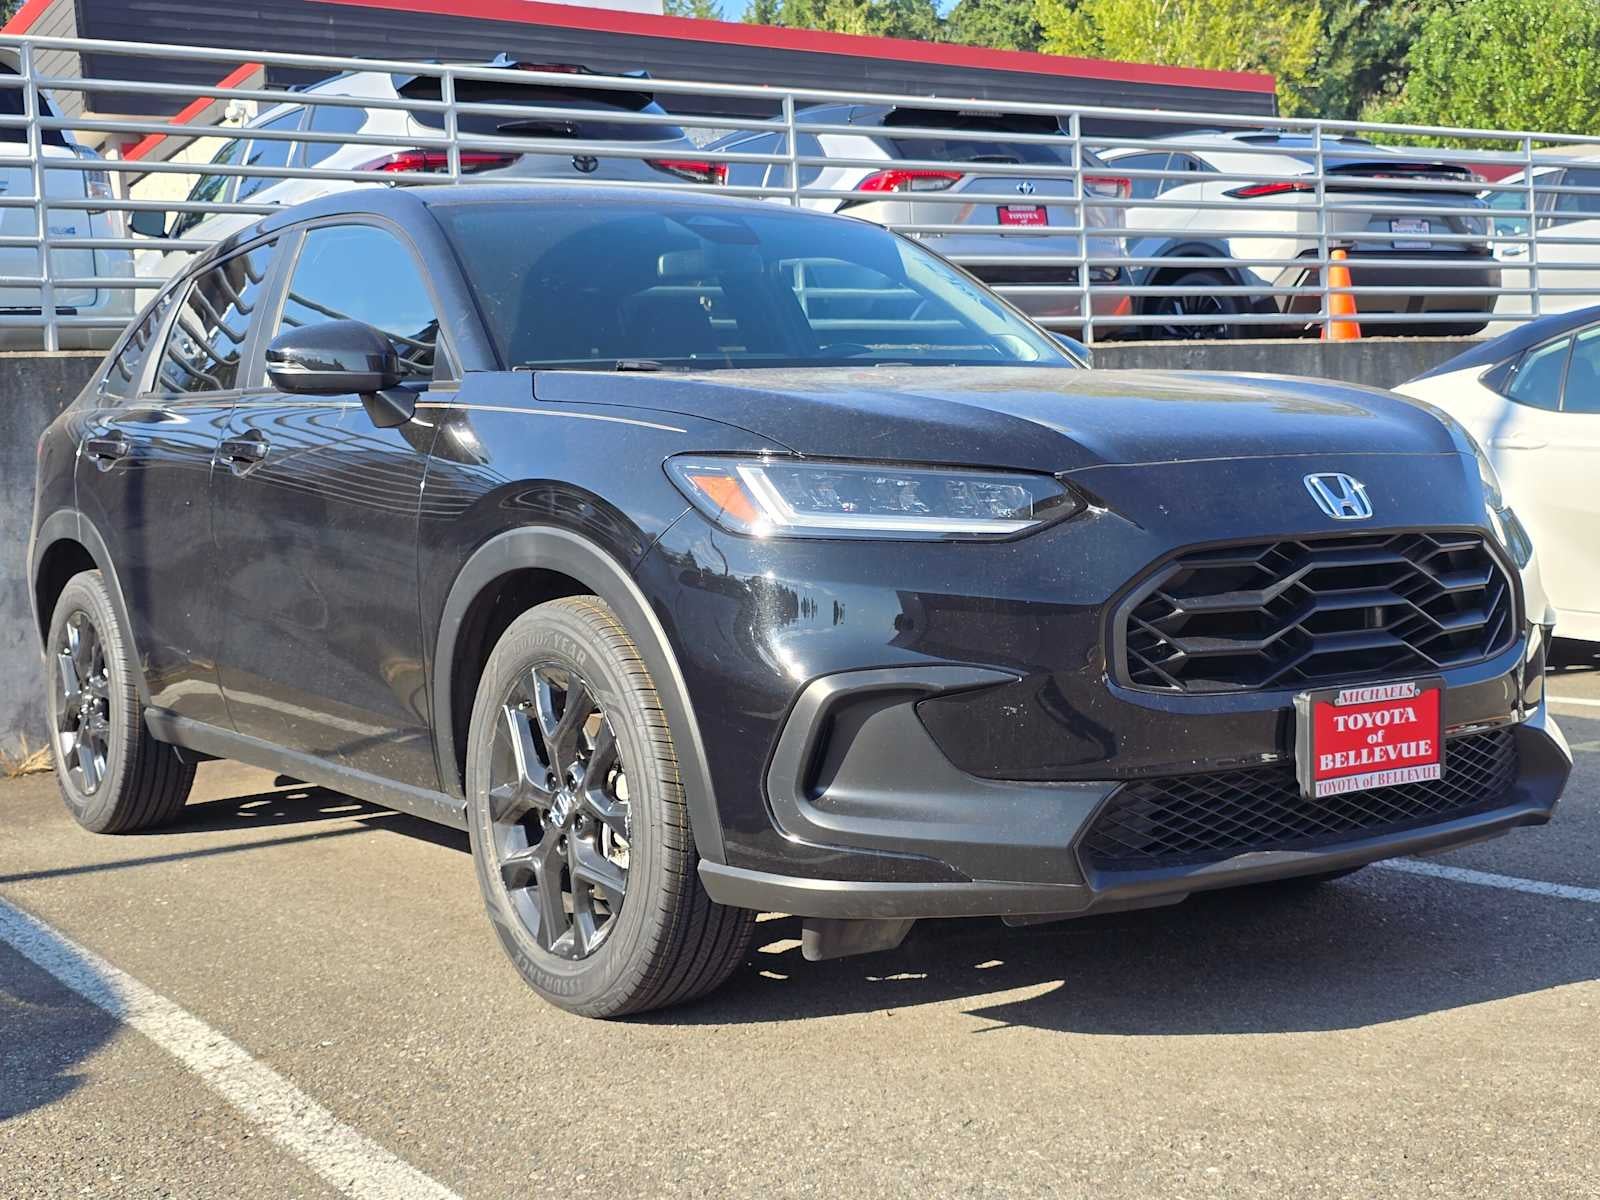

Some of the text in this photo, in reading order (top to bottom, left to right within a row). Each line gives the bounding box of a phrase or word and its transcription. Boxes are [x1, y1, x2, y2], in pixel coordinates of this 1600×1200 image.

[1342, 684, 1414, 702] MICHAELS
[1334, 707, 1417, 732] TOYOTA
[1367, 730, 1385, 744] of
[1320, 740, 1432, 771] BELLEVUE
[1317, 766, 1438, 796] TOYOTA of BELLEVUE
